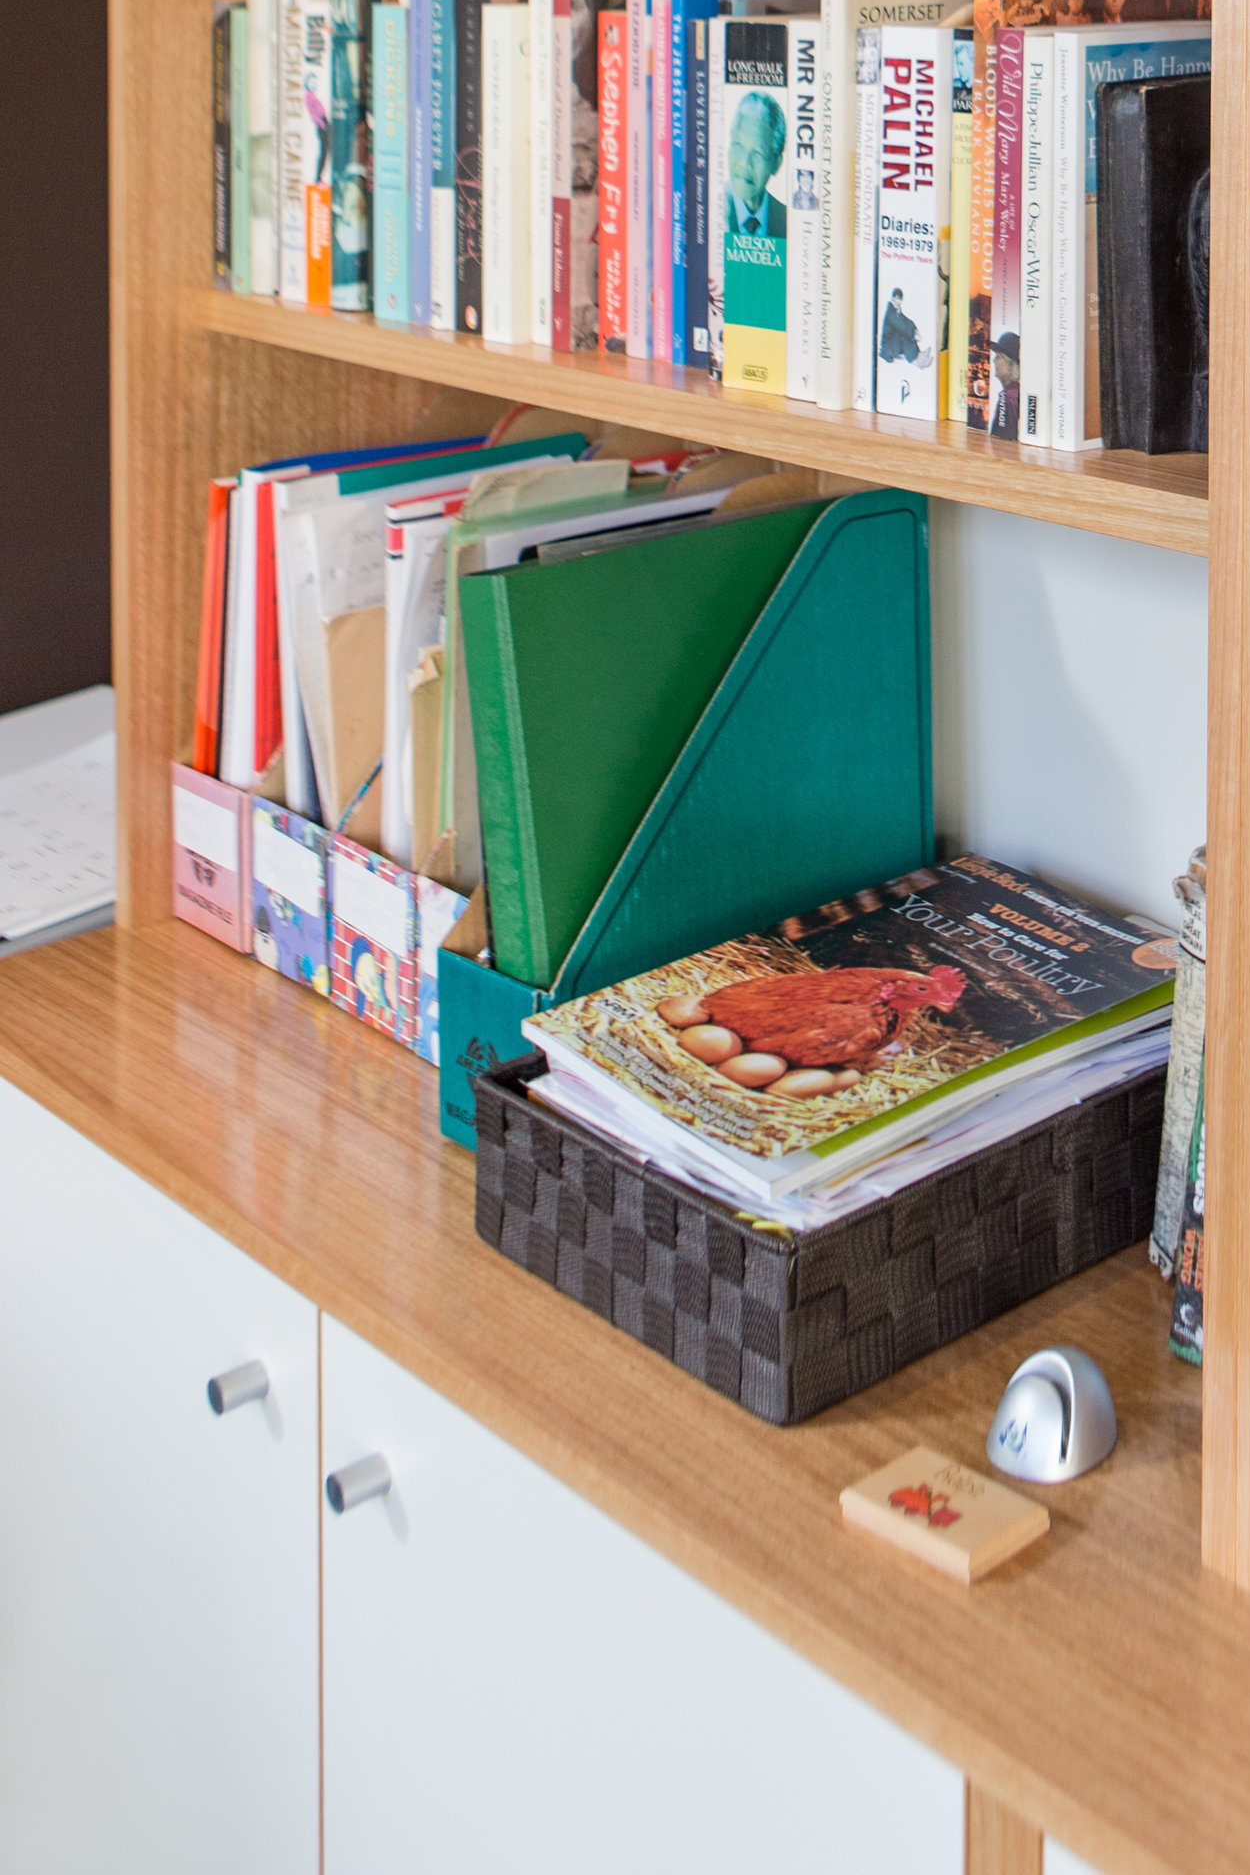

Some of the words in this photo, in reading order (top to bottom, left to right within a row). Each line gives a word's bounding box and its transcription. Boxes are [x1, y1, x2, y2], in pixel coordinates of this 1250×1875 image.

[672, 13, 683, 44] The
[858, 3, 945, 24] SOMERSET
[284, 5, 305, 127] MICHAEL
[305, 14, 326, 67] Billy
[796, 38, 816, 86] MR
[999, 32, 1023, 99] Wild
[672, 47, 683, 109] JERSEY
[727, 60, 756, 74] LONG
[756, 61, 785, 75] WALK
[737, 73, 785, 87] FREEDOM
[984, 44, 998, 119] BLOOD
[1087, 60, 1127, 83] Why
[1132, 58, 1154, 79] Be
[599, 47, 623, 172] Stephen
[694, 69, 707, 170] LOVELOCK
[822, 71, 833, 172] SOMERSET
[972, 78, 984, 150] FRANK
[1026, 61, 1044, 134] Philippe
[1057, 94, 1069, 151] Winterson
[430, 78, 442, 172] FORSTER
[672, 110, 682, 149] LILY
[795, 96, 815, 161] NICE
[882, 57, 912, 192] PALIN
[914, 58, 935, 193] MICHAEL
[997, 99, 1018, 167] Mary
[284, 131, 304, 209] CAINE
[983, 126, 997, 210] WASHES
[1026, 133, 1043, 192] Jullian
[1057, 156, 1068, 180] Why
[599, 179, 622, 236] Fry
[970, 159, 983, 255] VIVIANO
[997, 171, 1009, 208] Mary
[1056, 193, 1068, 236] Happy
[733, 235, 775, 253] NELSON
[821, 172, 832, 270] MAUGHAM
[880, 215, 934, 237] Diaries:
[880, 236, 934, 253] 1969-1979
[997, 209, 1010, 253] Wesley
[1025, 201, 1042, 261] Oscar
[726, 248, 783, 268] MANDELA
[880, 251, 893, 260] The
[892, 253, 916, 264] Python
[917, 256, 934, 265] Years
[981, 217, 995, 291] BLOOD
[1056, 237, 1068, 270] When
[819, 298, 831, 315] his
[820, 271, 831, 296] and
[1025, 258, 1041, 309] Wilde
[1056, 271, 1068, 292] You
[819, 316, 832, 360] world
[1056, 296, 1068, 331] Could
[1056, 333, 1067, 348] Be
[1055, 349, 1068, 400] Normal?
[997, 390, 1008, 429] VINTAGE
[1056, 404, 1066, 441] VINTAGE
[995, 872, 1032, 895] Block
[889, 892, 977, 939] Your
[964, 931, 1106, 997] Poultry
[965, 910, 1002, 931] How
[998, 925, 1015, 938] to
[1011, 931, 1049, 954] Care
[1043, 947, 1071, 962] for
[988, 902, 1074, 948] VOLUME
[1071, 940, 1092, 954] 2
[600, 997, 638, 1021] NRM
[1179, 1228, 1197, 1286] WONG
